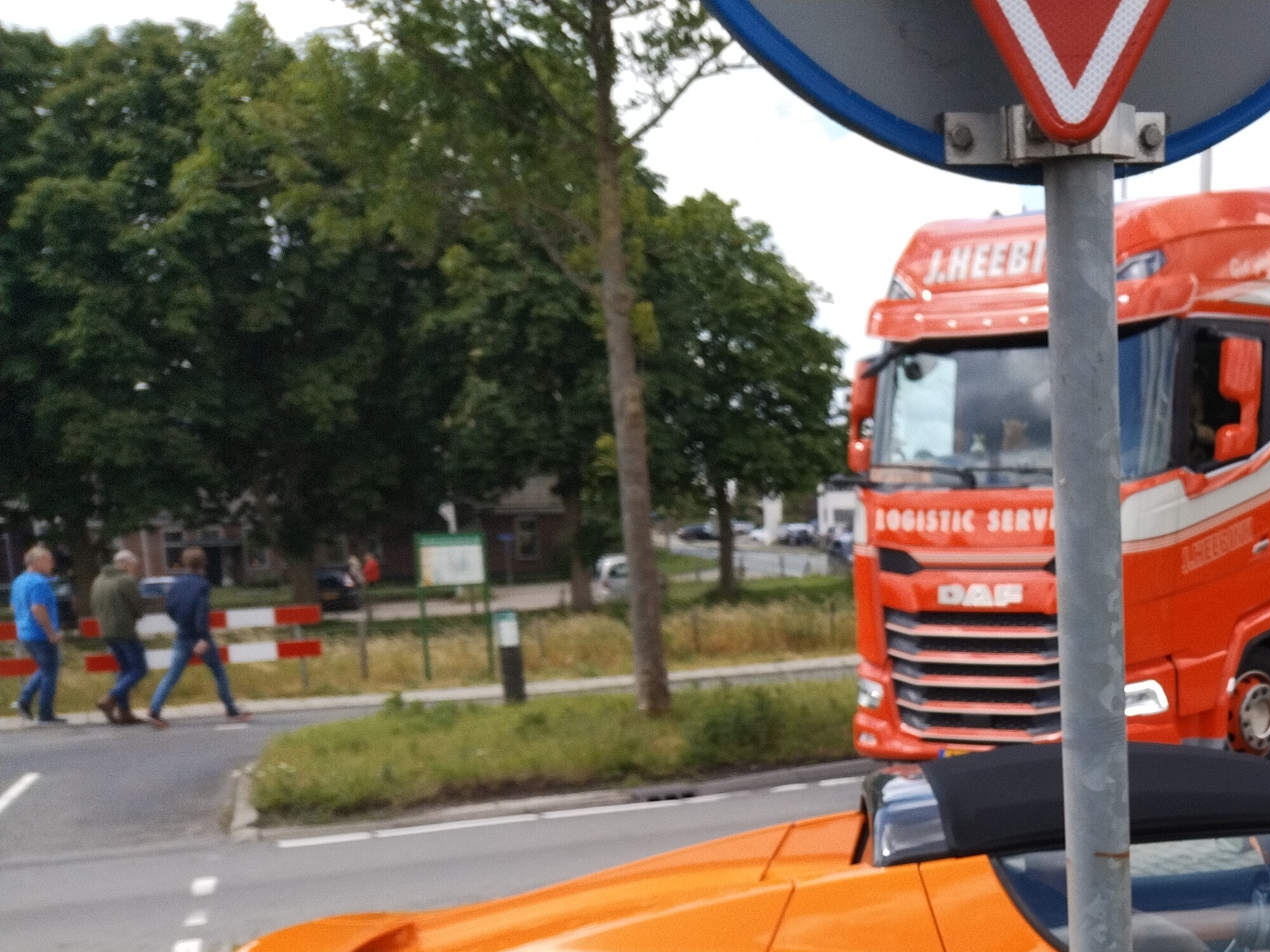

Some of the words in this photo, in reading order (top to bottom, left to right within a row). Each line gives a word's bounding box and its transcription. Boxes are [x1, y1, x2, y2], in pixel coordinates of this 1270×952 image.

[923, 239, 1047, 285] J.HEEBI
[875, 508, 974, 532] LOGISTIC
[986, 508, 1056, 532] SERVI
[937, 583, 1023, 608] DAF
